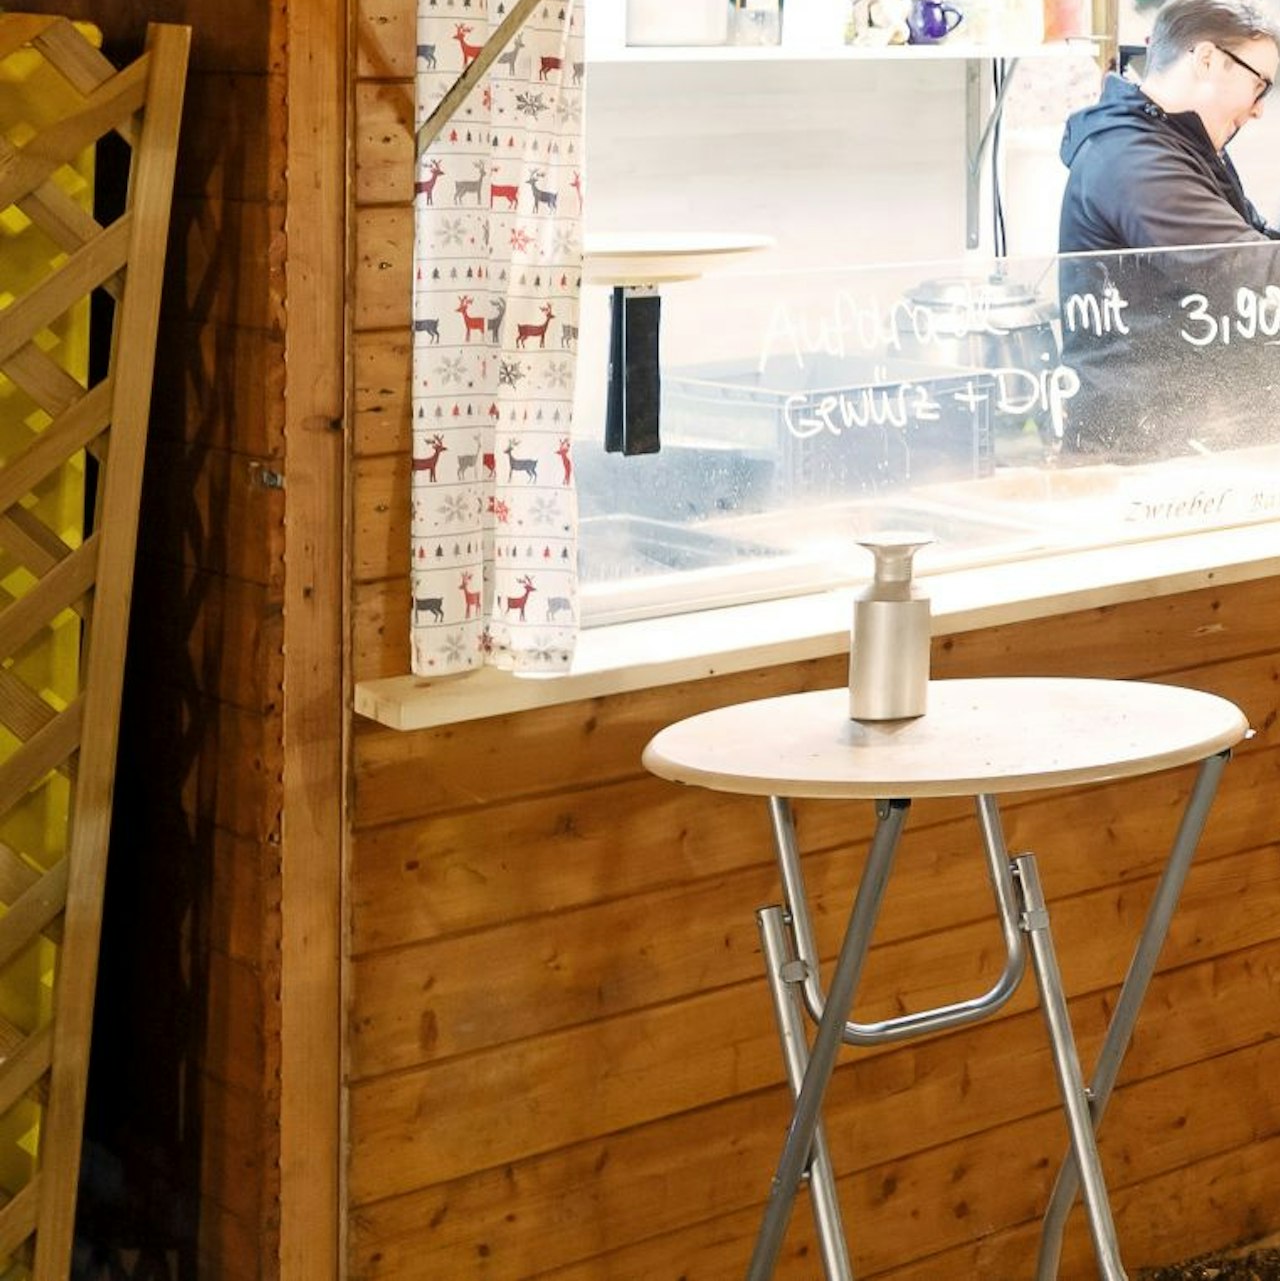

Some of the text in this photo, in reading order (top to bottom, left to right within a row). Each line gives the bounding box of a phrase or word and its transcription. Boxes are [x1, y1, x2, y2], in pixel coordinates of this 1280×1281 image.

[1066, 287, 1130, 336] mit
[784, 352, 1081, 439] Gewürz + Dip
